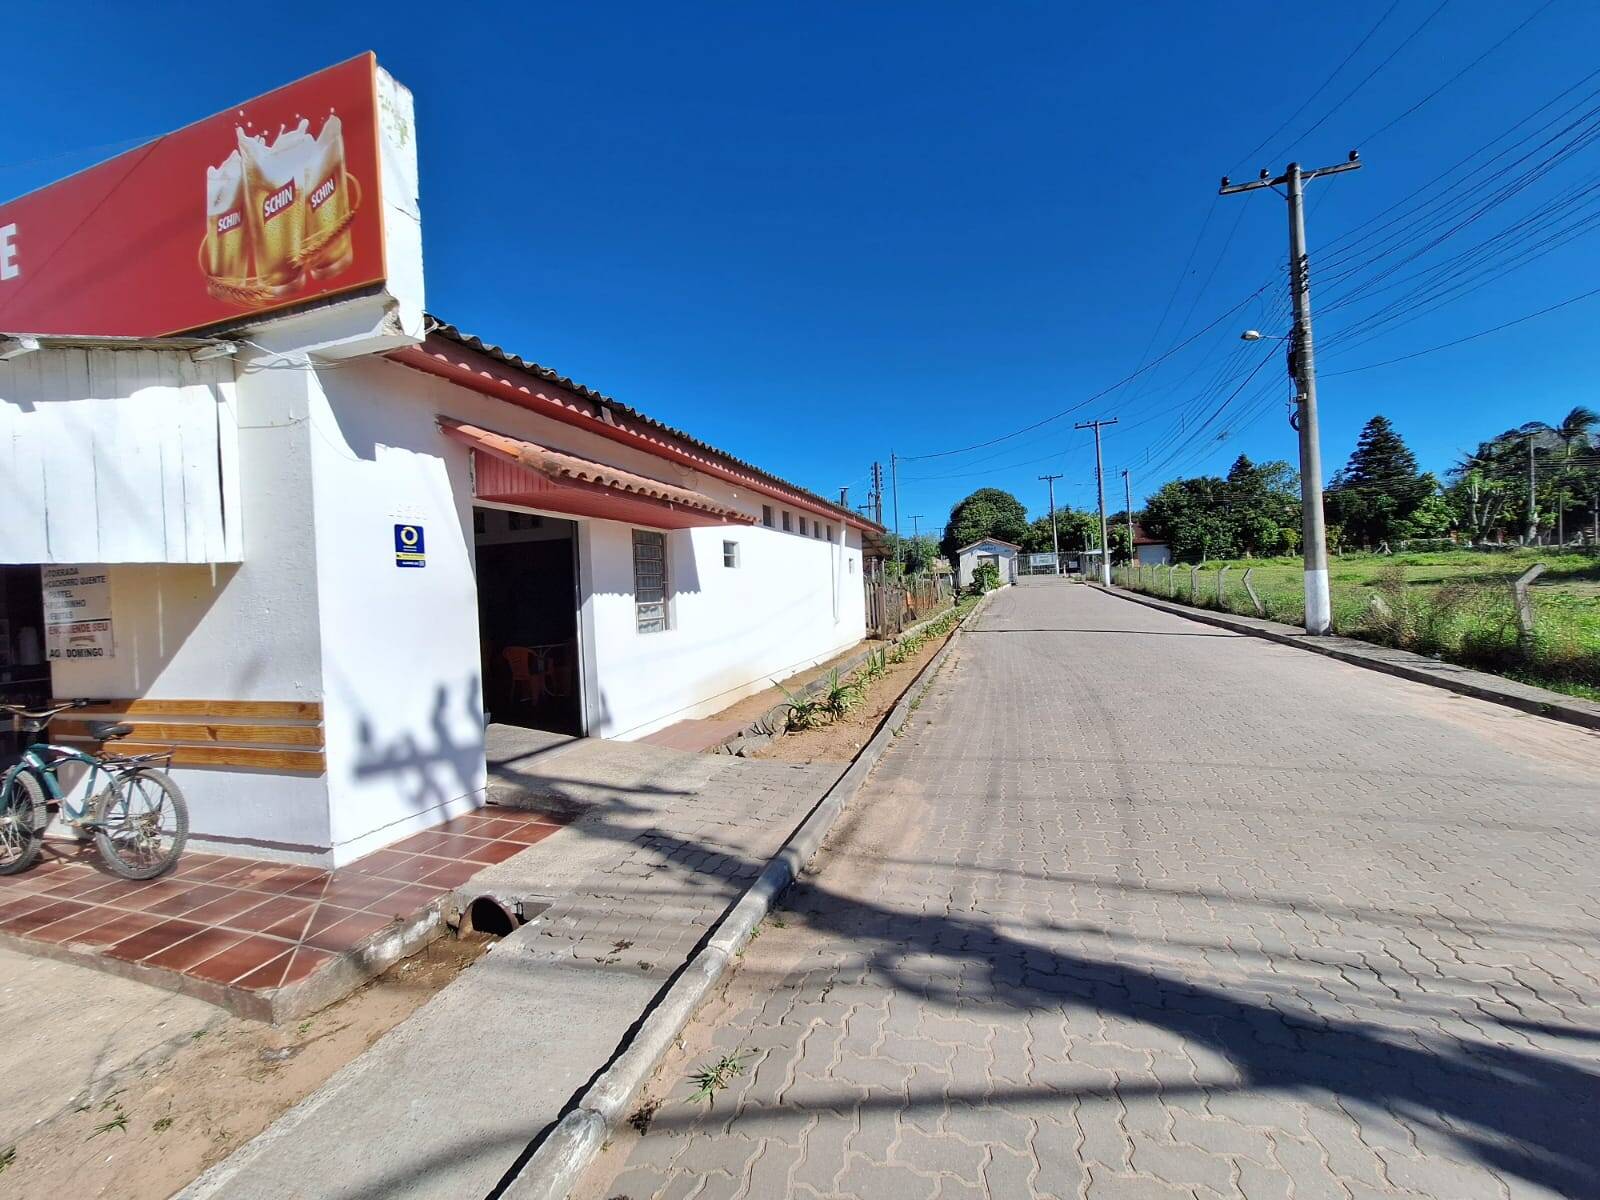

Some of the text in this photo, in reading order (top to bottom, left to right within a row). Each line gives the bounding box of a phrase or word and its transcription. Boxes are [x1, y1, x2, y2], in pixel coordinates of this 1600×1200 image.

[264, 186, 293, 218] SCHIN
[311, 179, 335, 208] SCHIN
[217, 211, 241, 233] SCHIN
[66, 648, 103, 657] DOMINGO
